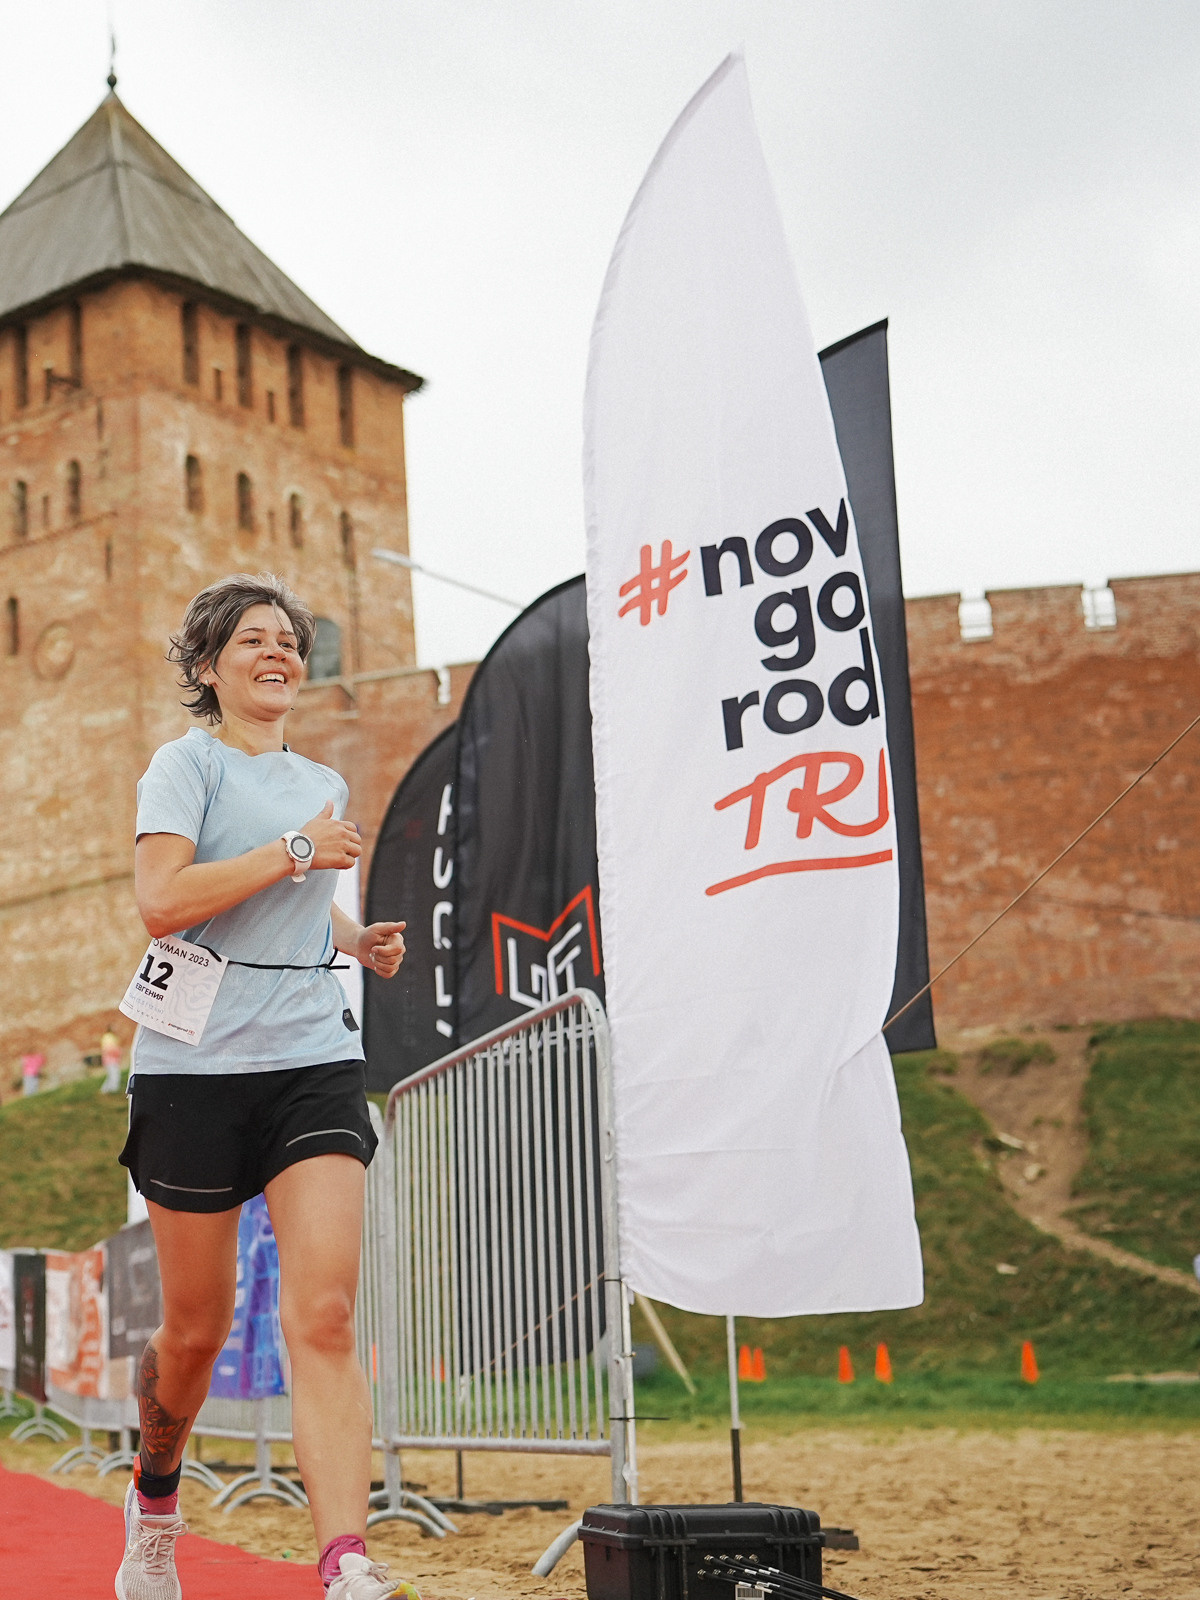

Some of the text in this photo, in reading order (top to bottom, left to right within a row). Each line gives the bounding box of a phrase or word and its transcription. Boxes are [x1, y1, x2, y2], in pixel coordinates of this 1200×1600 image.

[618, 497, 849, 626] #nov
[754, 571, 866, 671] go
[721, 627, 881, 751] rod
[714, 747, 890, 850] TRI
[135, 982, 164, 1001] ЕВГЕНИЯ
[139, 953, 174, 991] 12
[152, 938, 210, 967] OVMAN 2023
